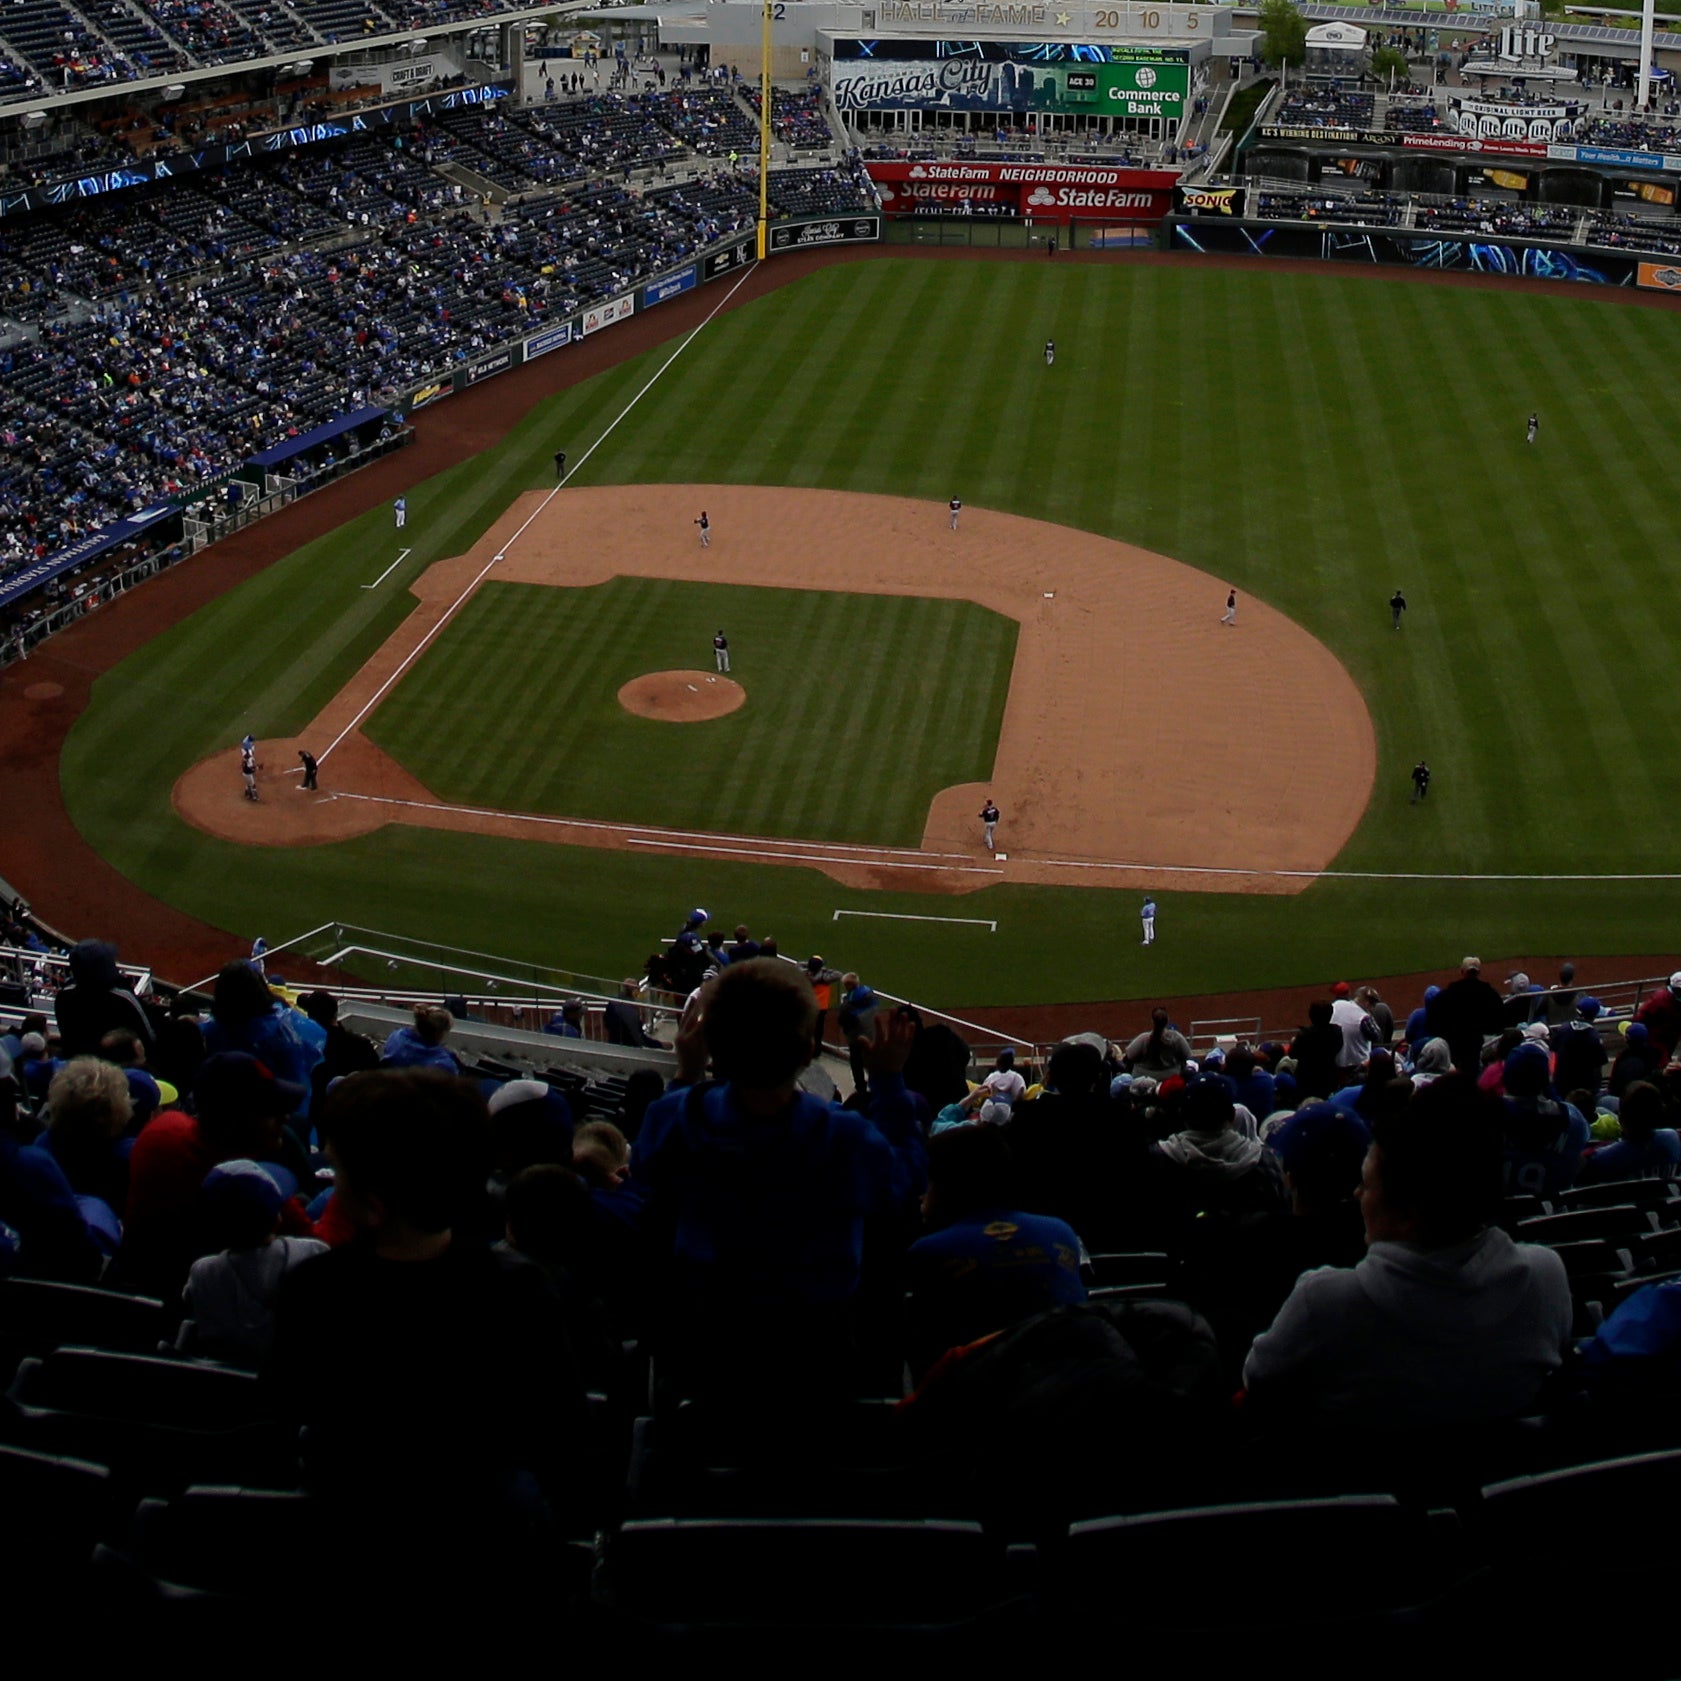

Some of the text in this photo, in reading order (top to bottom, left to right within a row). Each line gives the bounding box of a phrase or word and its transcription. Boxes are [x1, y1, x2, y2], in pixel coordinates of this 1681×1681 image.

[881, 1, 1045, 24] HALL of FAME
[1096, 10, 1119, 28] 20
[1140, 11, 1159, 28] 10
[1187, 13, 1198, 29] 5
[1498, 26, 1556, 62] Lite
[393, 69, 410, 82] CRAFT
[415, 65, 432, 77] DRAFT
[836, 59, 993, 109] Kansas City
[1069, 77, 1095, 87] ACE 30
[1109, 87, 1180, 102] Commerce
[1127, 102, 1162, 115] Bank
[1474, 104, 1556, 117] ORIGINAL LIGHT BEER
[1480, 118, 1500, 134] Lite
[1504, 120, 1525, 135] Lite
[1531, 121, 1550, 137] Lite
[1403, 136, 1465, 150] PrimeLending
[999, 168, 1117, 184] NEIGHBORHOOD
[1186, 193, 1232, 207] SONIC
